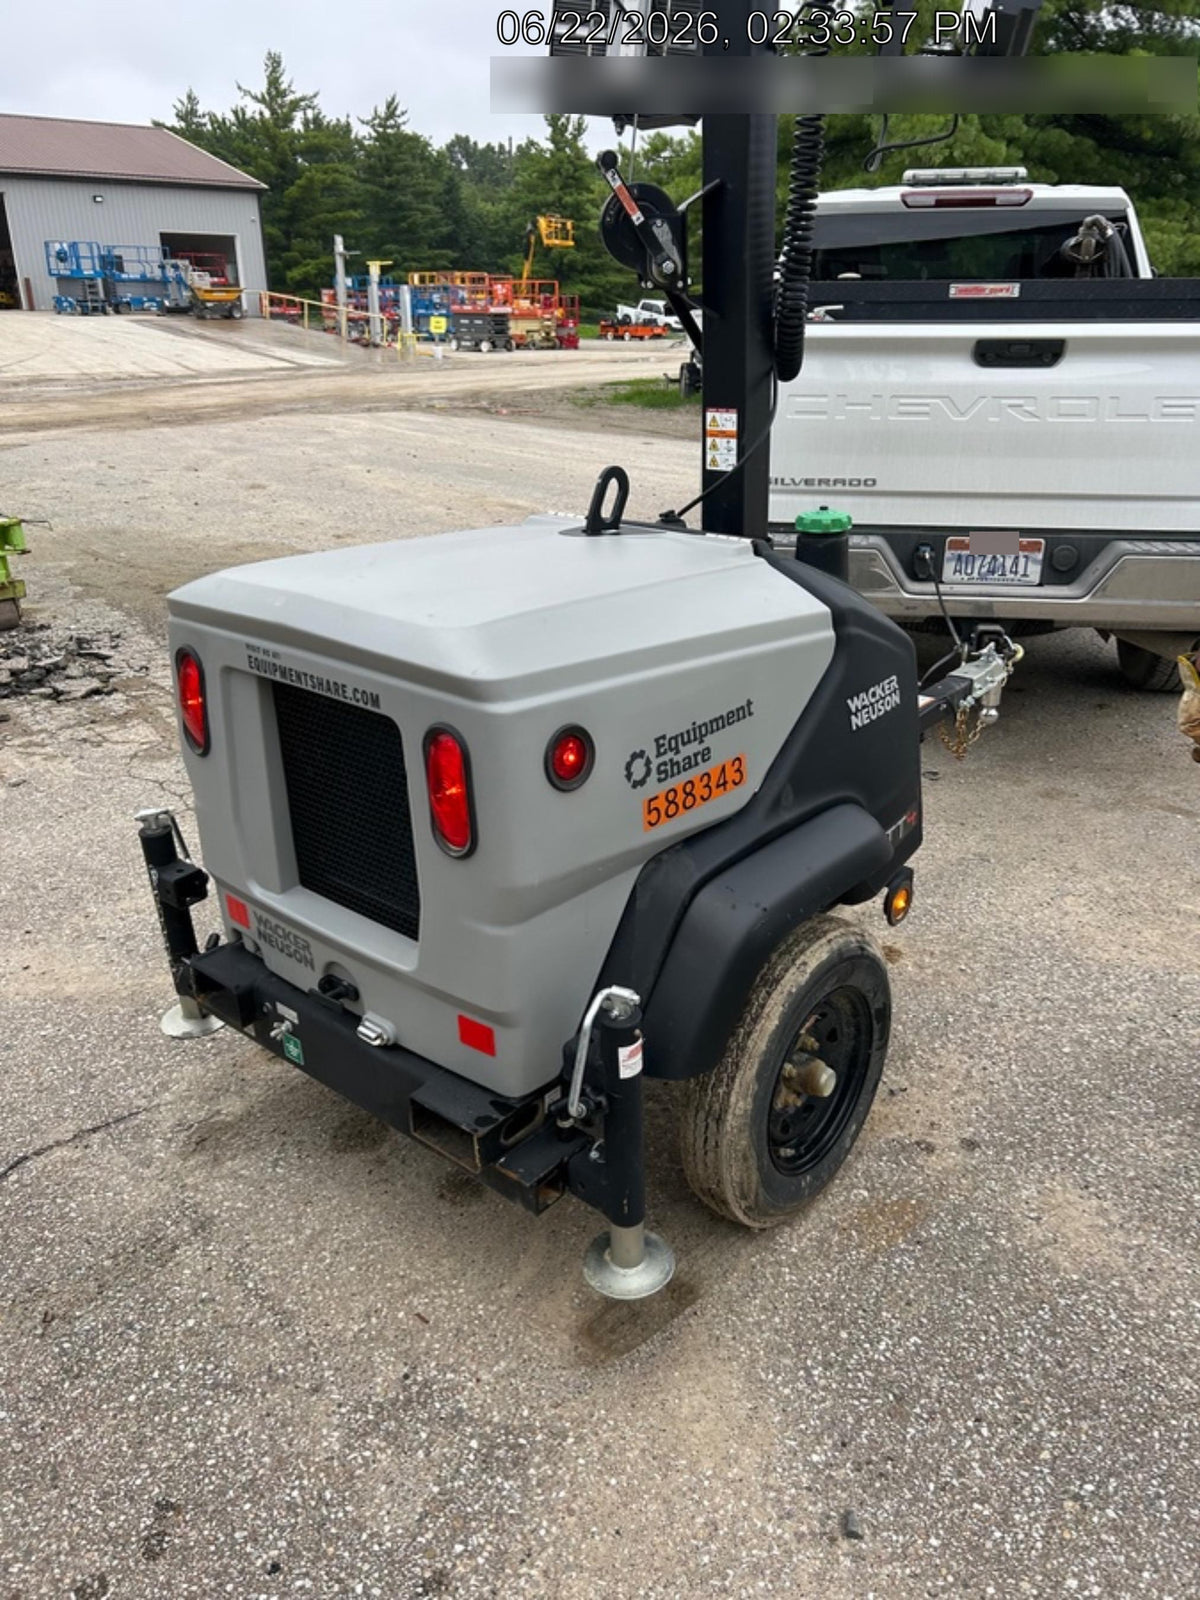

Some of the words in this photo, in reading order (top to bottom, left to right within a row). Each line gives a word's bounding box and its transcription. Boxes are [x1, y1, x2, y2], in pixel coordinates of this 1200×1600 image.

[786, 394, 1200, 423] CHEVROLE
[247, 654, 381, 710] EQUIPMENTSHARE.COM
[847, 675, 899, 714] WACKER
[654, 698, 754, 758] Equipment
[850, 690, 900, 731] NEUSON
[656, 746, 712, 783] Share
[646, 756, 745, 828] 588343
[253, 911, 313, 951] WACKER
[256, 926, 315, 972] NEUSON
